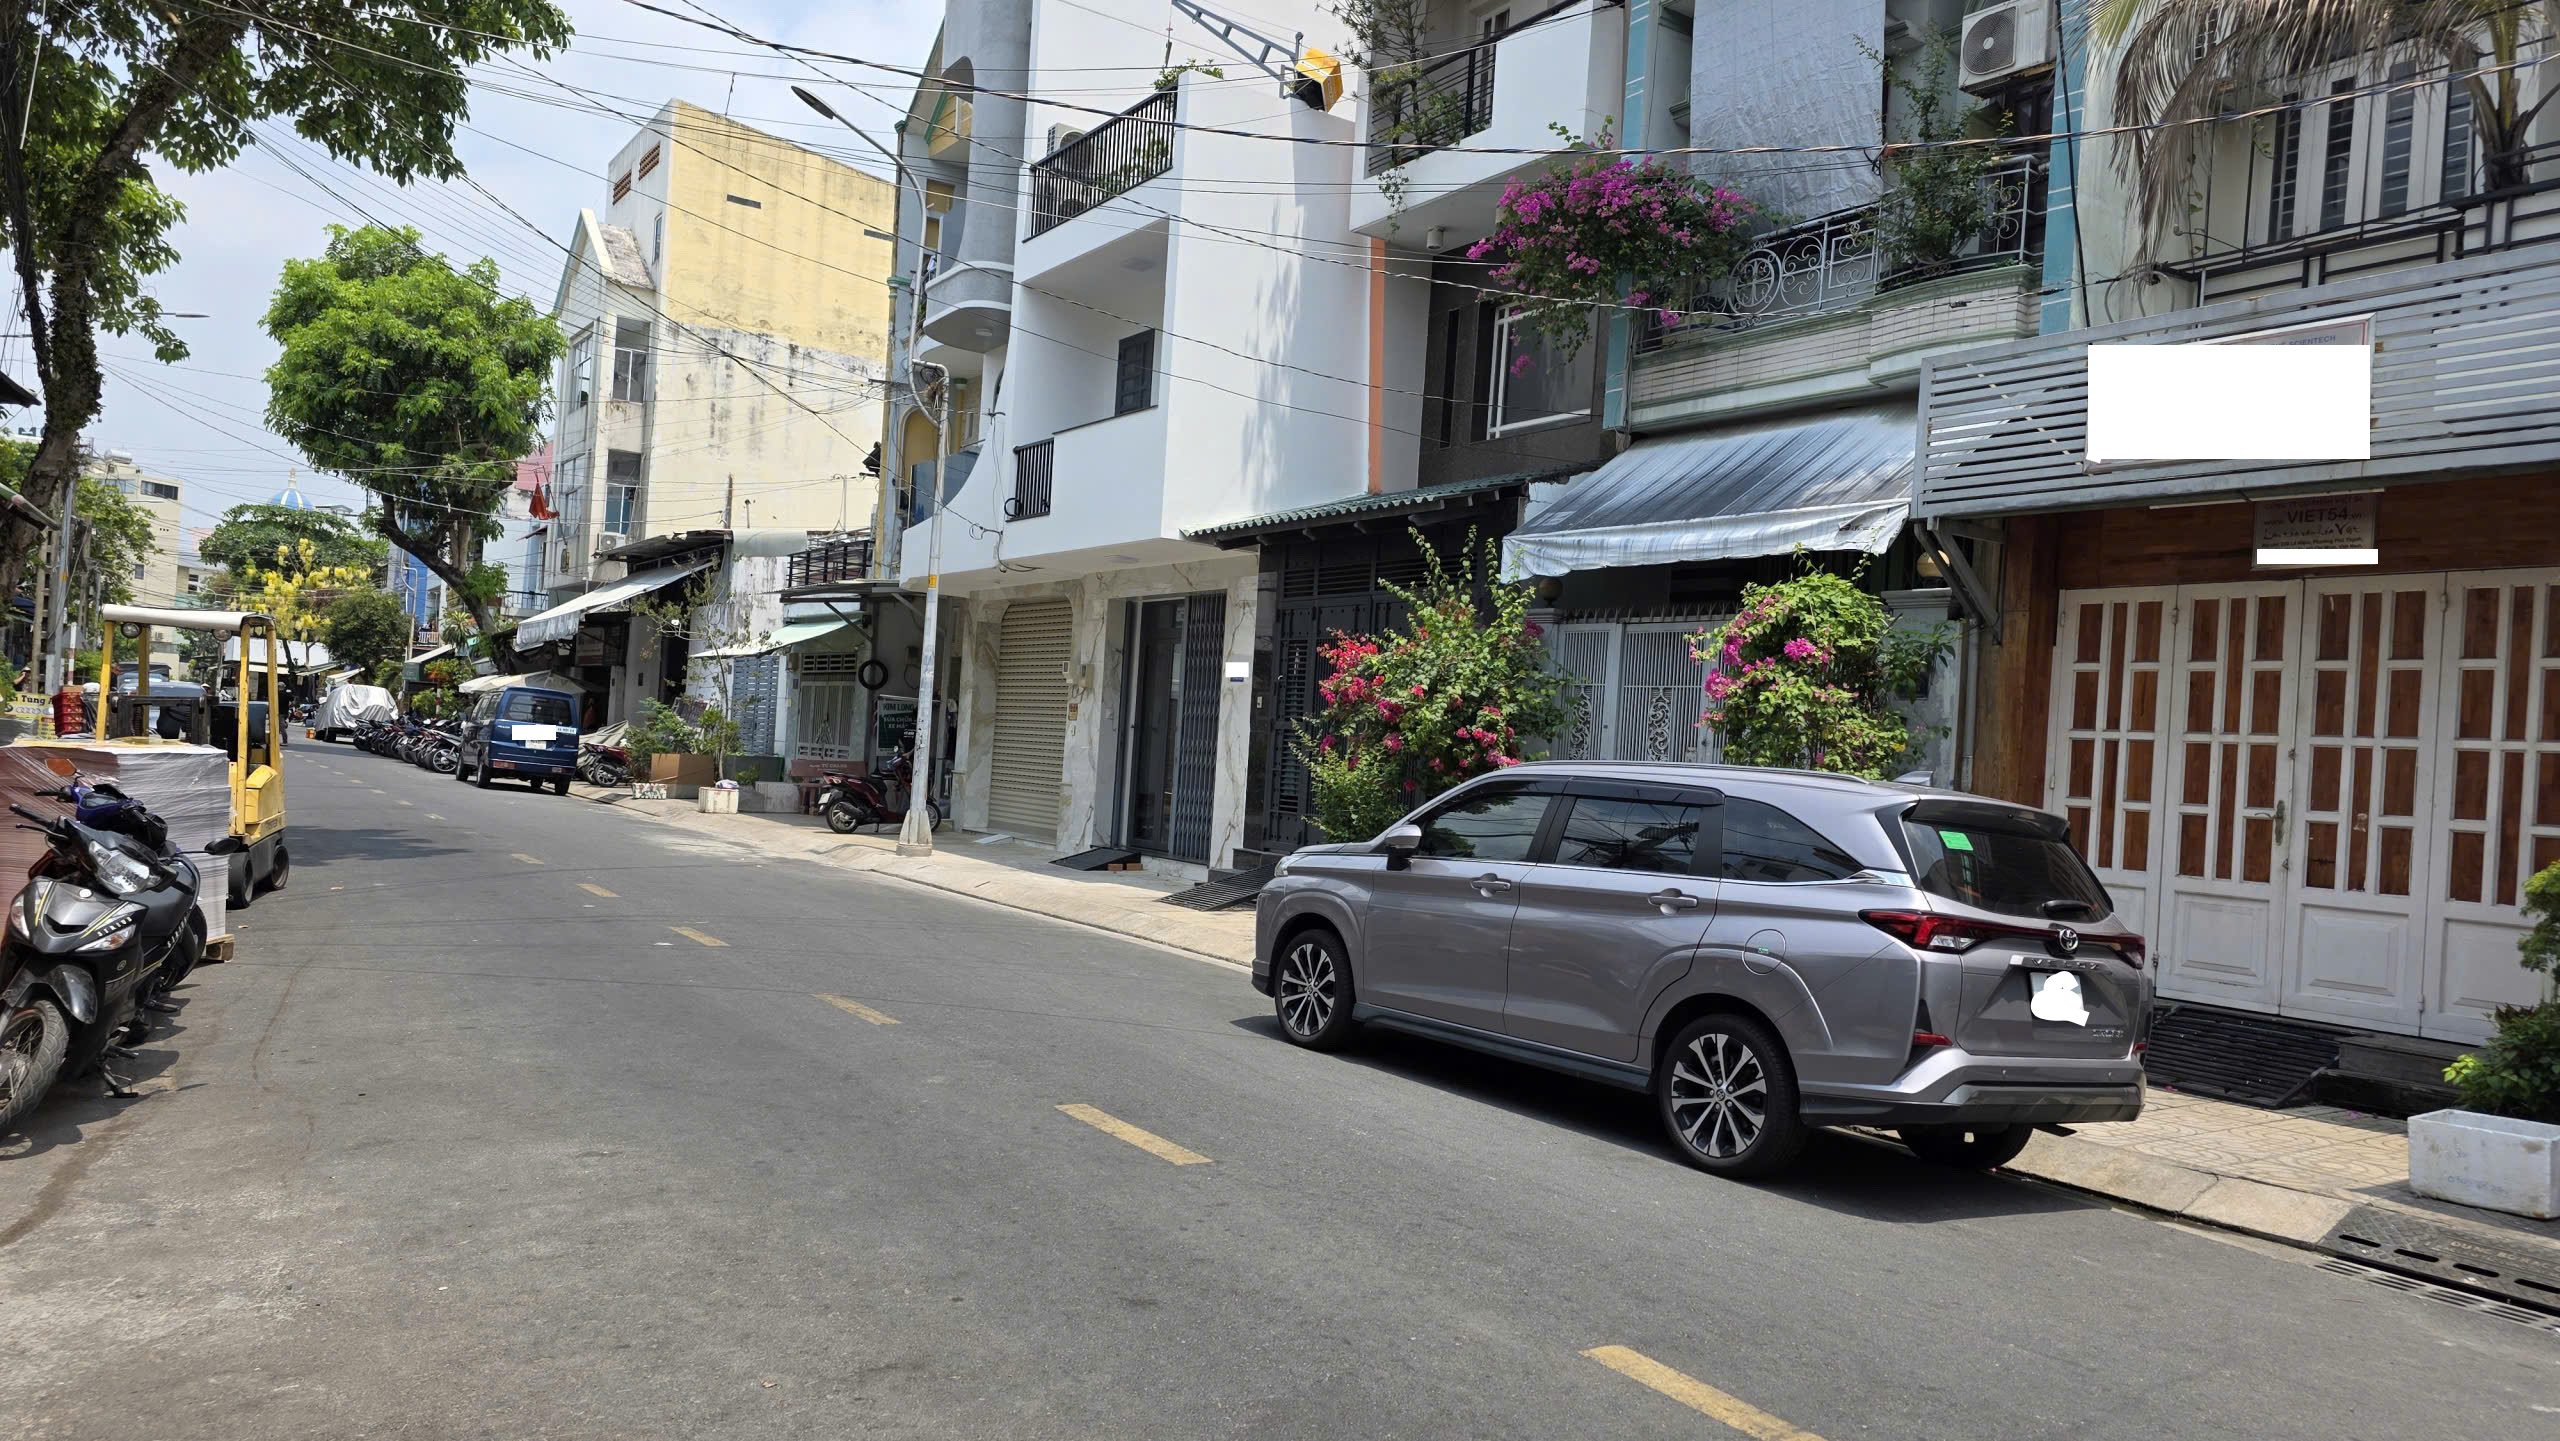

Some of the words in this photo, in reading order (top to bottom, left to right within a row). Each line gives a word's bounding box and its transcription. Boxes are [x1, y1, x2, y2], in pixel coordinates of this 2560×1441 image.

[2287, 506, 2347, 524] VIET54
[883, 703, 896, 711] KIM
[97, 916, 133, 937] SIRIUS
